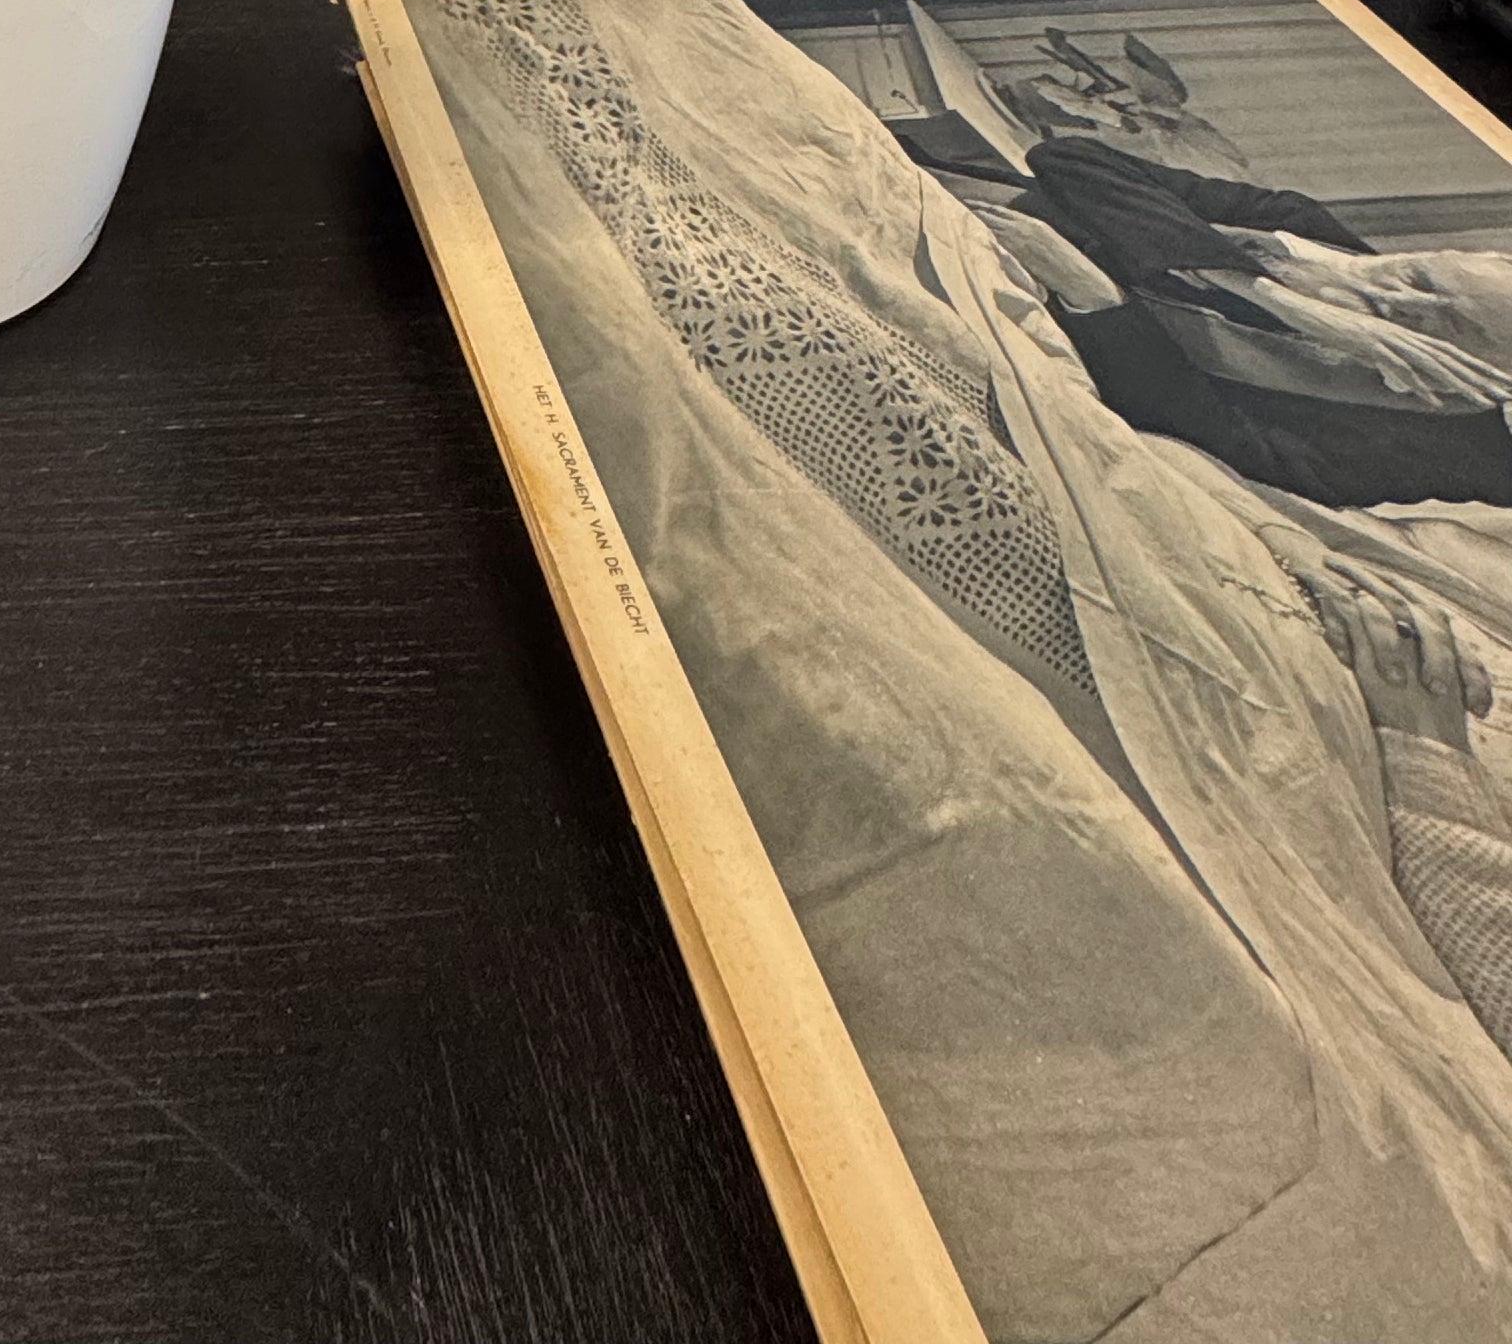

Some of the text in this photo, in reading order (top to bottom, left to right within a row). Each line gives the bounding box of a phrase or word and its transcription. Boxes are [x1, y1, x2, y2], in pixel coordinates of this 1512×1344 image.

[533, 385, 552, 408] HET
[552, 432, 596, 512] SACRAMENT
[590, 519, 612, 549] VAN
[604, 557, 624, 576] DE
[615, 583, 649, 635] BIECHT
